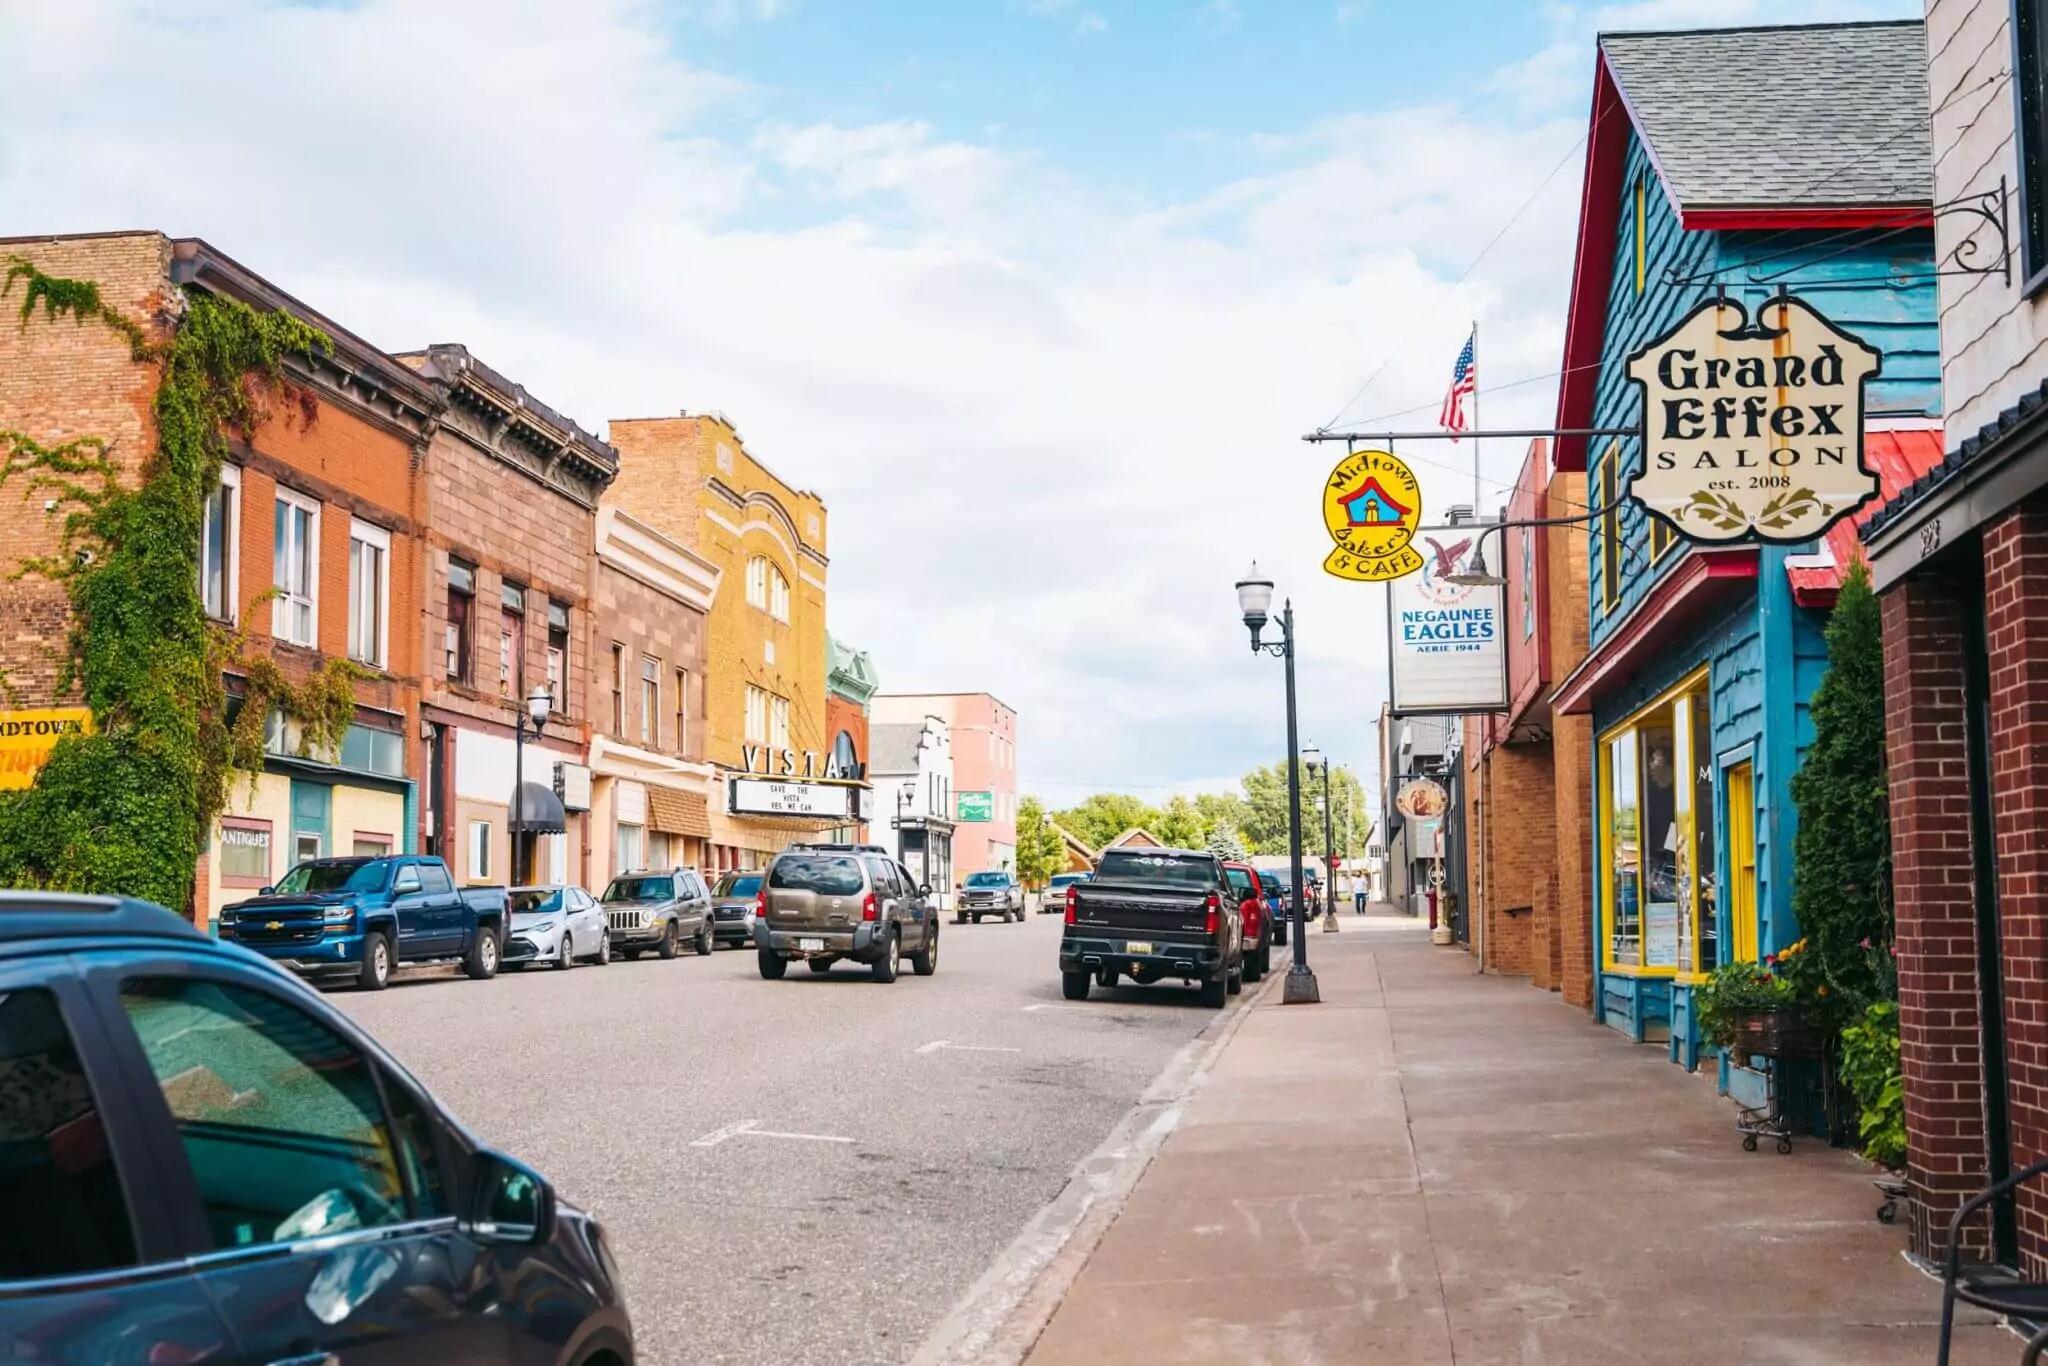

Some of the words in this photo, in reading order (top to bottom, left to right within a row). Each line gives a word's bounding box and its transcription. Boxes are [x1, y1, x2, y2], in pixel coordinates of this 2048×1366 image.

[1658, 344, 1845, 390] Grand
[1661, 396, 1844, 440] Effex
[1656, 446, 1846, 470] SALON
[1330, 455, 1415, 492] Midtown
[1708, 479, 1740, 490] est.
[1749, 476, 1791, 489] 2008
[1335, 527, 1411, 555] Bakery
[1335, 554, 1351, 569] &
[1402, 608, 1494, 623] NEGAUNEE
[1404, 622, 1494, 641] EAGLES
[1416, 645, 1450, 653] AERIE
[1455, 644, 1480, 652] 1944
[743, 745, 839, 778] VISTA
[770, 785, 786, 793] SAVE
[797, 786, 808, 795] THE
[771, 802, 783, 810] YES
[800, 803, 812, 811] CAN
[221, 830, 270, 848] ANTIQUES
